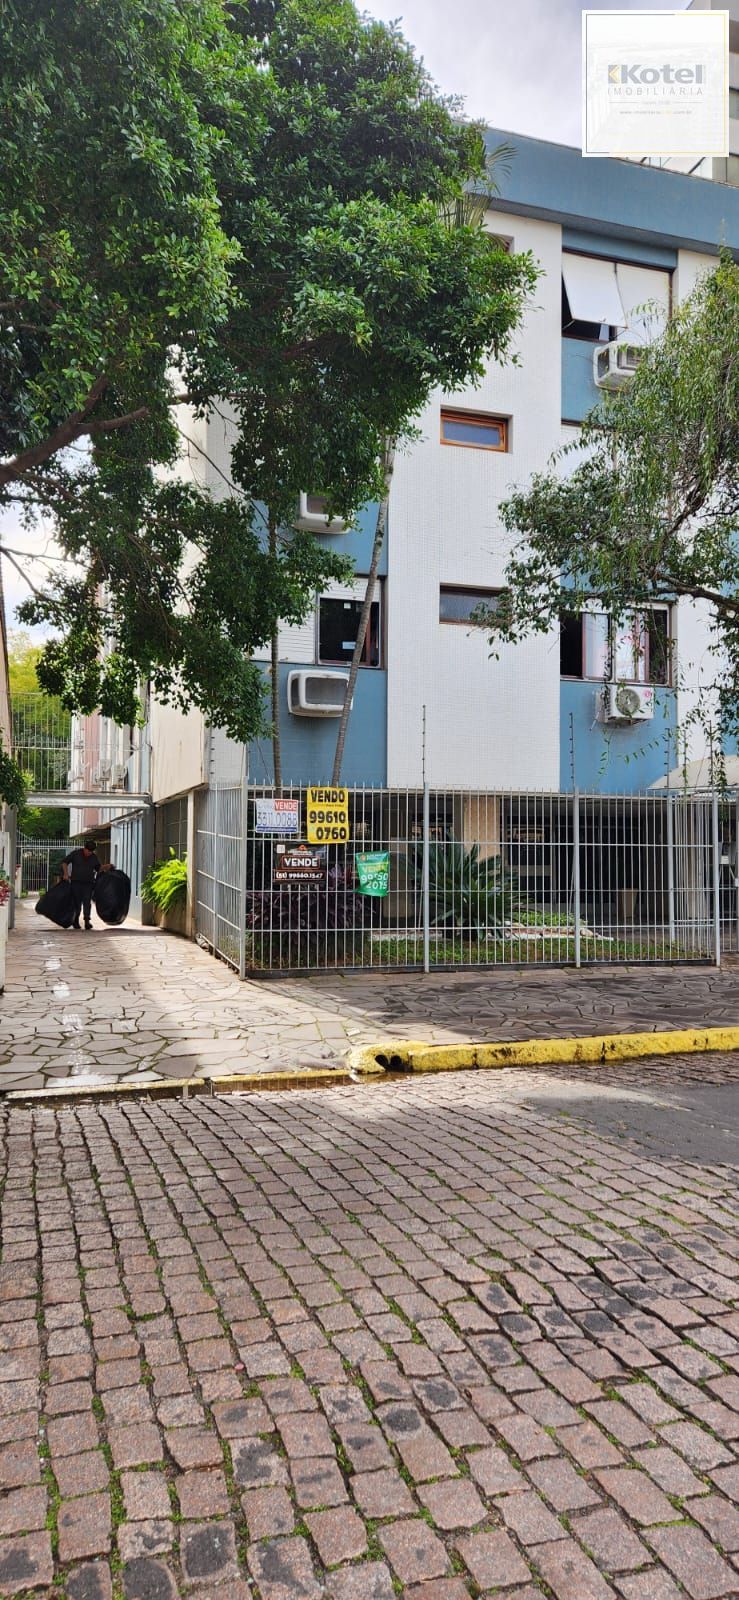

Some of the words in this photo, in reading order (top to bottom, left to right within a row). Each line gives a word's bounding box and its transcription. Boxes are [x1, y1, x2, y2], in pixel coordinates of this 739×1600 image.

[310, 790, 345, 803] VENDO
[275, 801, 297, 810] VENDE
[309, 811, 346, 824] 99610
[316, 827, 347, 840] 0760
[284, 857, 318, 867] VENDE
